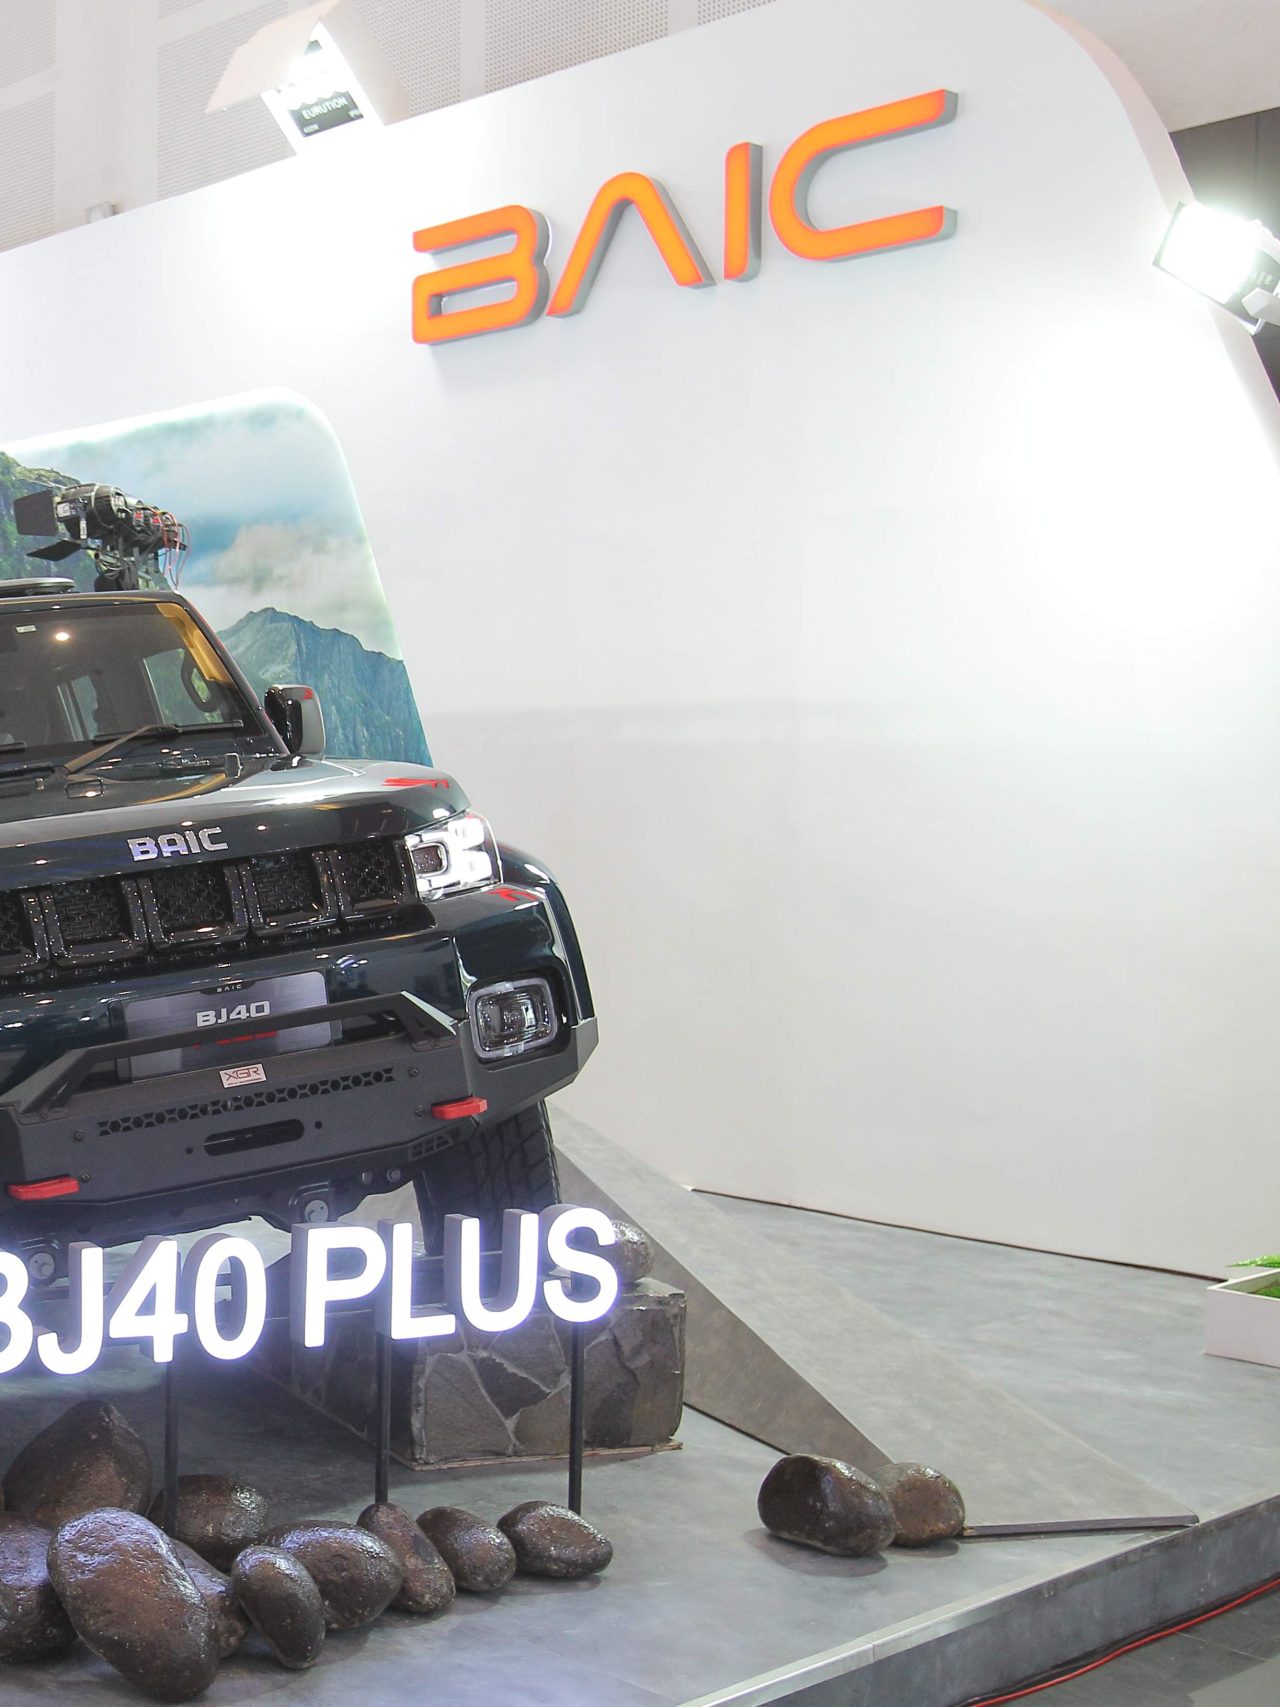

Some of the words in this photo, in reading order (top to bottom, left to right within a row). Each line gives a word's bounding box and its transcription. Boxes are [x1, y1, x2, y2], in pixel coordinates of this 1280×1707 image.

[301, 97, 348, 120] EURUTION
[412, 89, 958, 346] BAIC
[126, 826, 230, 862] BAIC
[216, 984, 243, 993] BAIC
[196, 1000, 271, 1028] BJ40
[290, 1206, 620, 1350] PLUS
